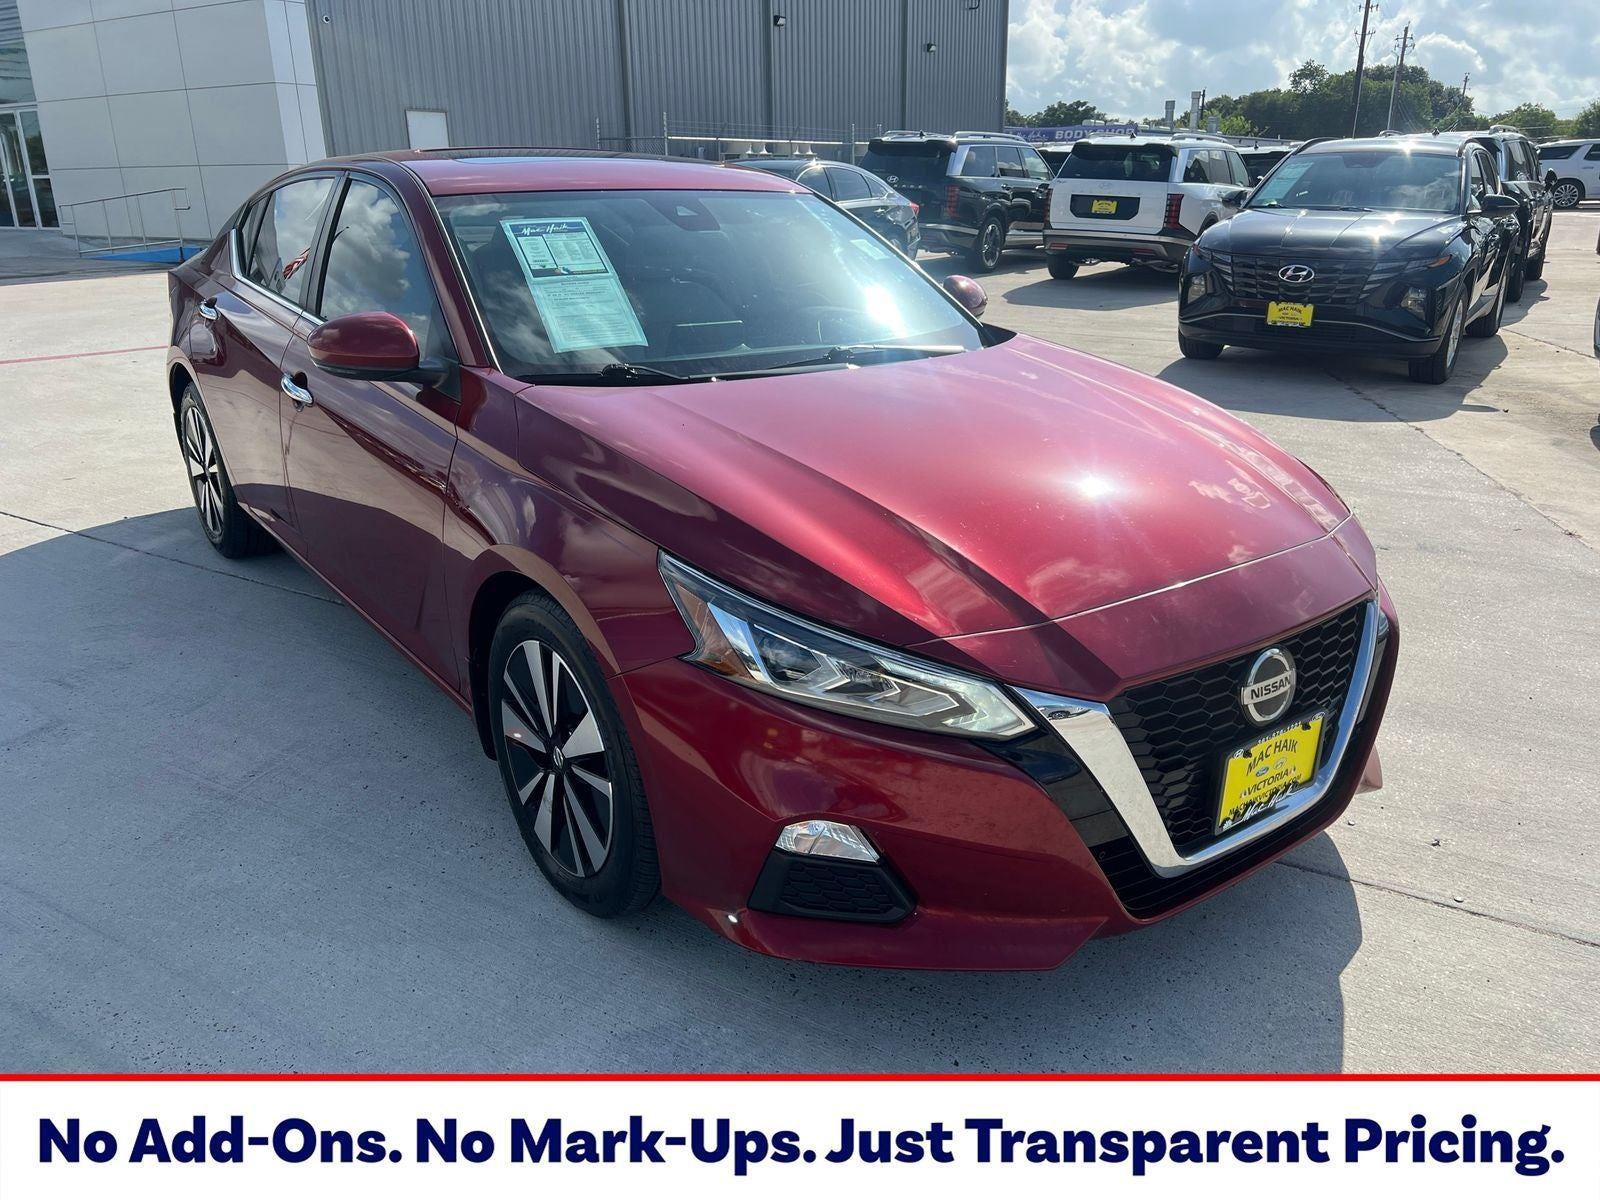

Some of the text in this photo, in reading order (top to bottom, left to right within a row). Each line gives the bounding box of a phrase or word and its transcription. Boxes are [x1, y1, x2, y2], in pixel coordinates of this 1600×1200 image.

[1055, 130, 1092, 140] BODY
[1250, 674, 1291, 700] NISSAN
[1246, 738, 1298, 776] MAC HAIK
[1247, 768, 1289, 796] VICTORIA
